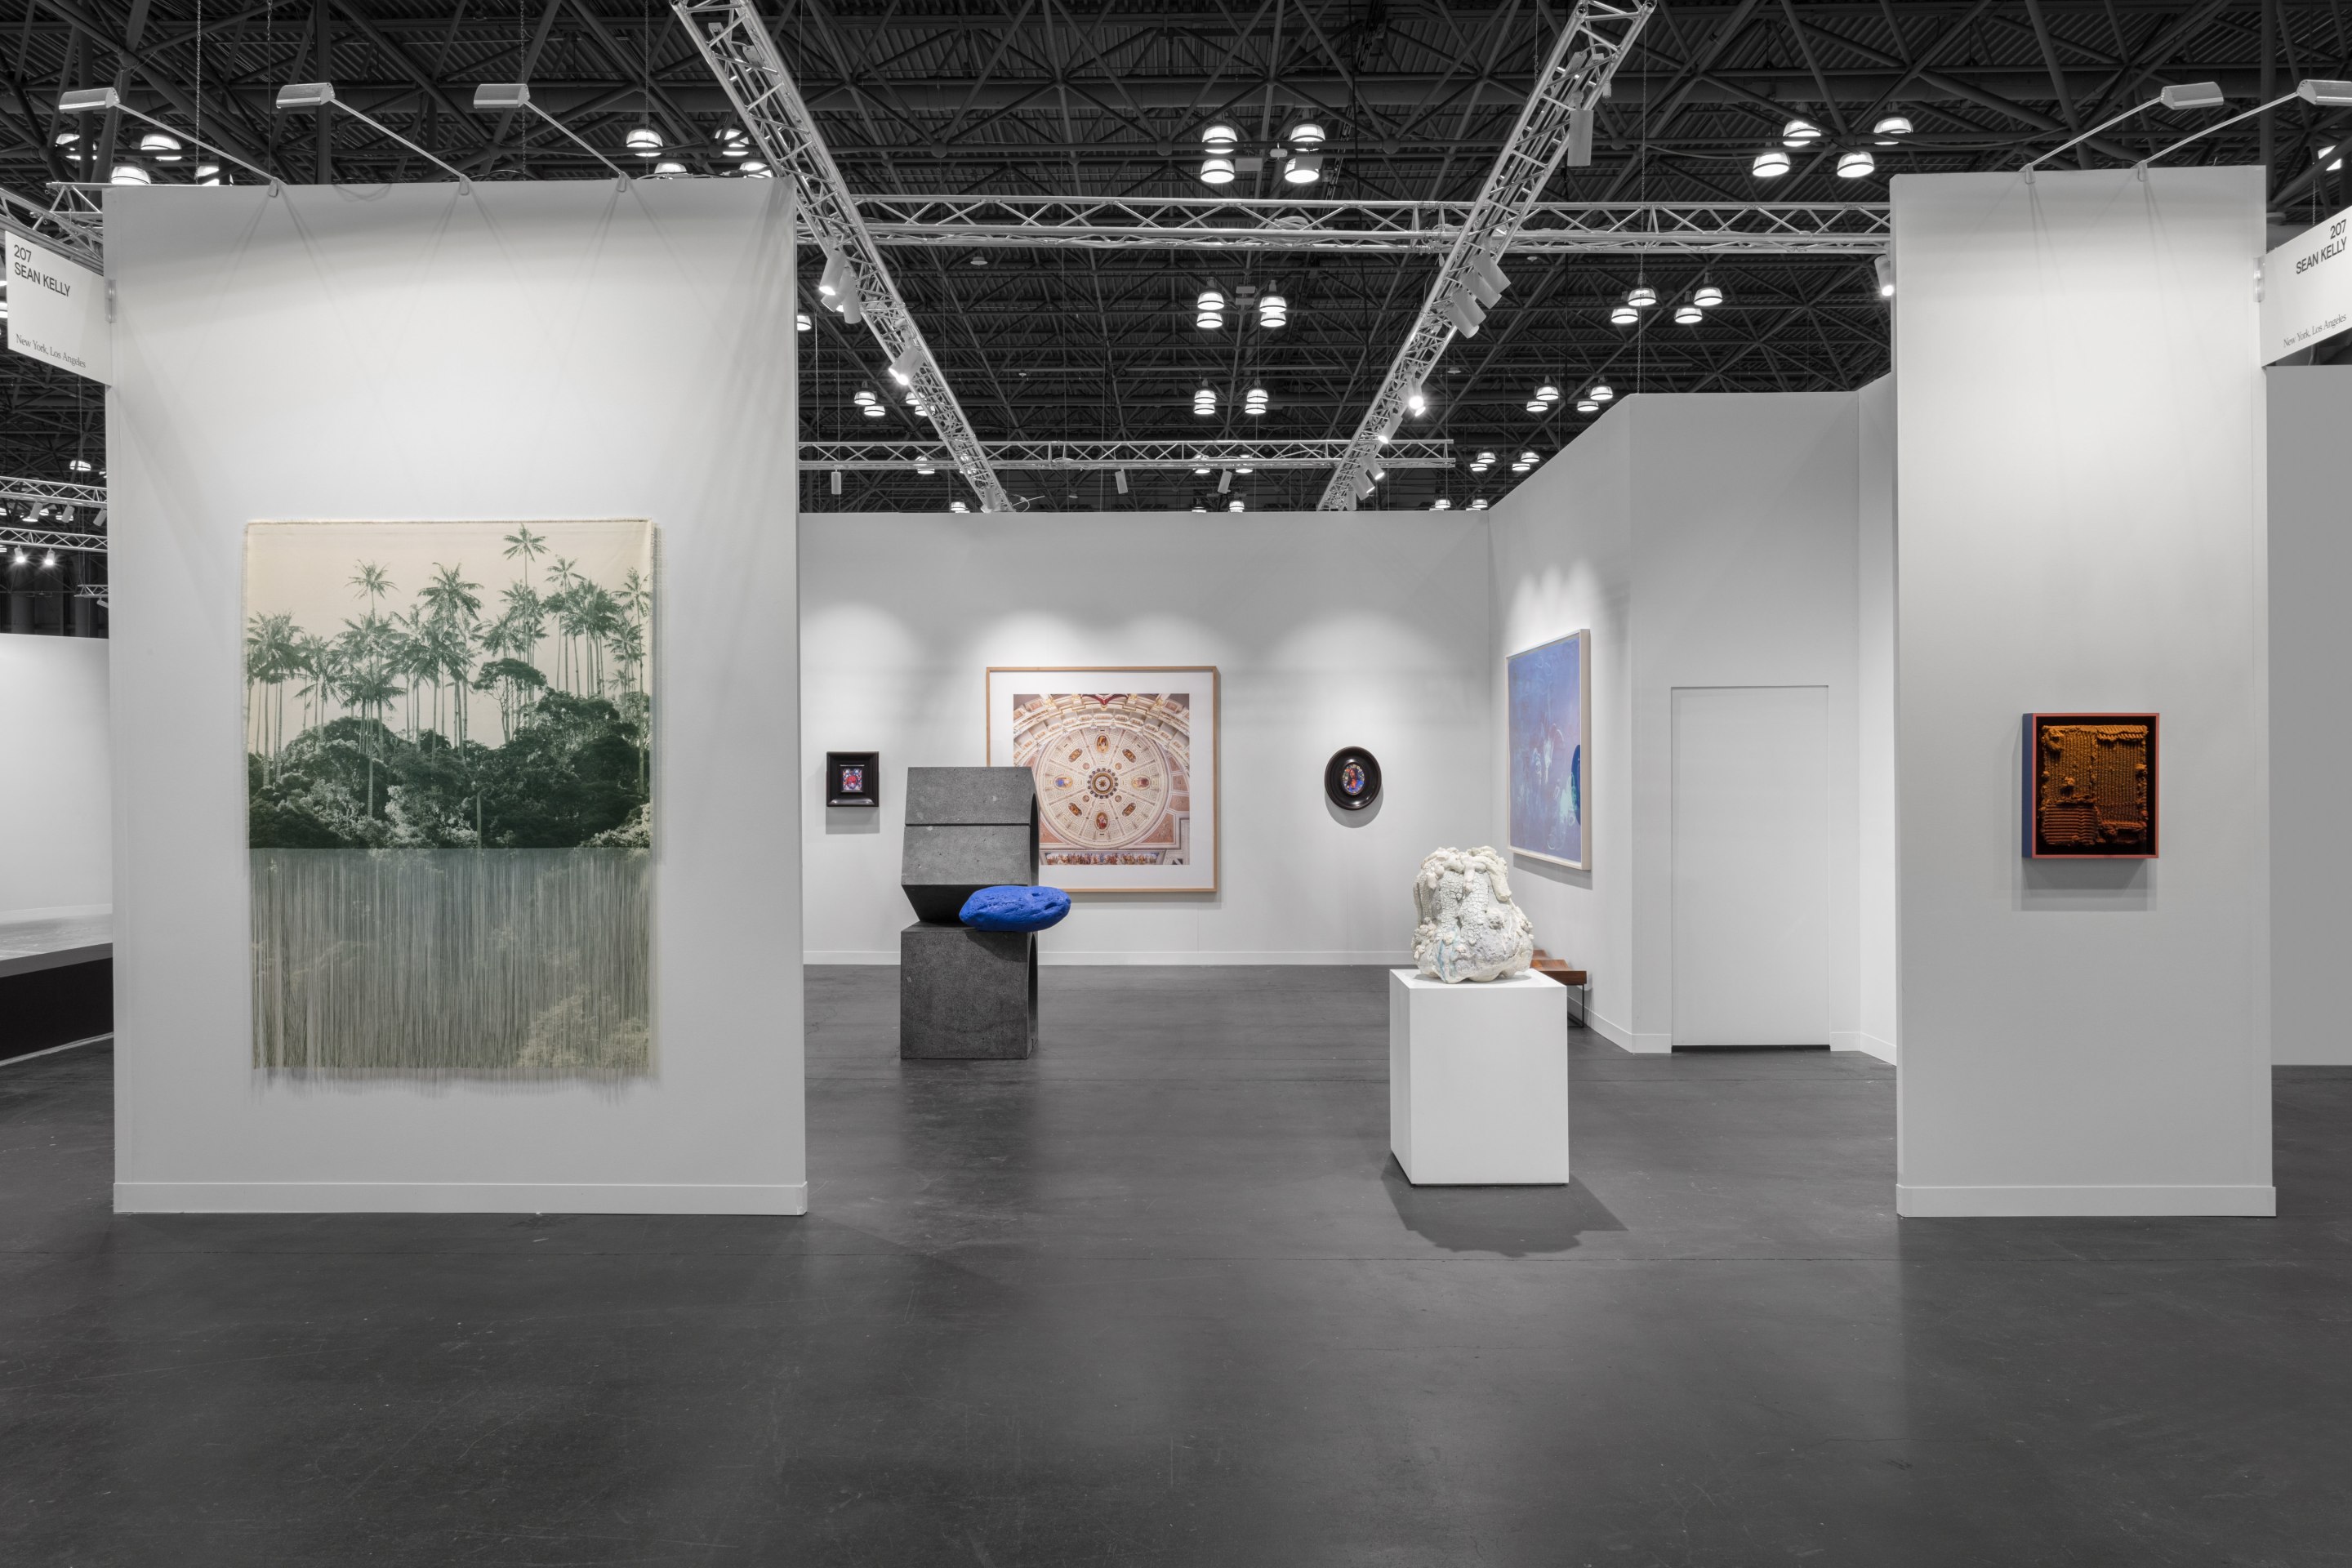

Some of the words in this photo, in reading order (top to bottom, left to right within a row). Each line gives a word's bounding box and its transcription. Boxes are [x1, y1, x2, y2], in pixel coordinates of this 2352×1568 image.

[2330, 218, 2347, 240] 207
[14, 244, 32, 263] 207
[2296, 251, 2319, 274] SEAN
[2320, 236, 2347, 263] KELLY
[14, 261, 41, 285] SEAN
[43, 274, 70, 297] KELLY
[2283, 336, 2296, 348] New
[2296, 328, 2311, 342] York,
[2312, 324, 2323, 335] Los
[2323, 313, 2347, 330] Angeles
[16, 333, 32, 347] New
[32, 339, 49, 355] York,
[50, 345, 61, 359] Los
[62, 352, 86, 368] Angeles
